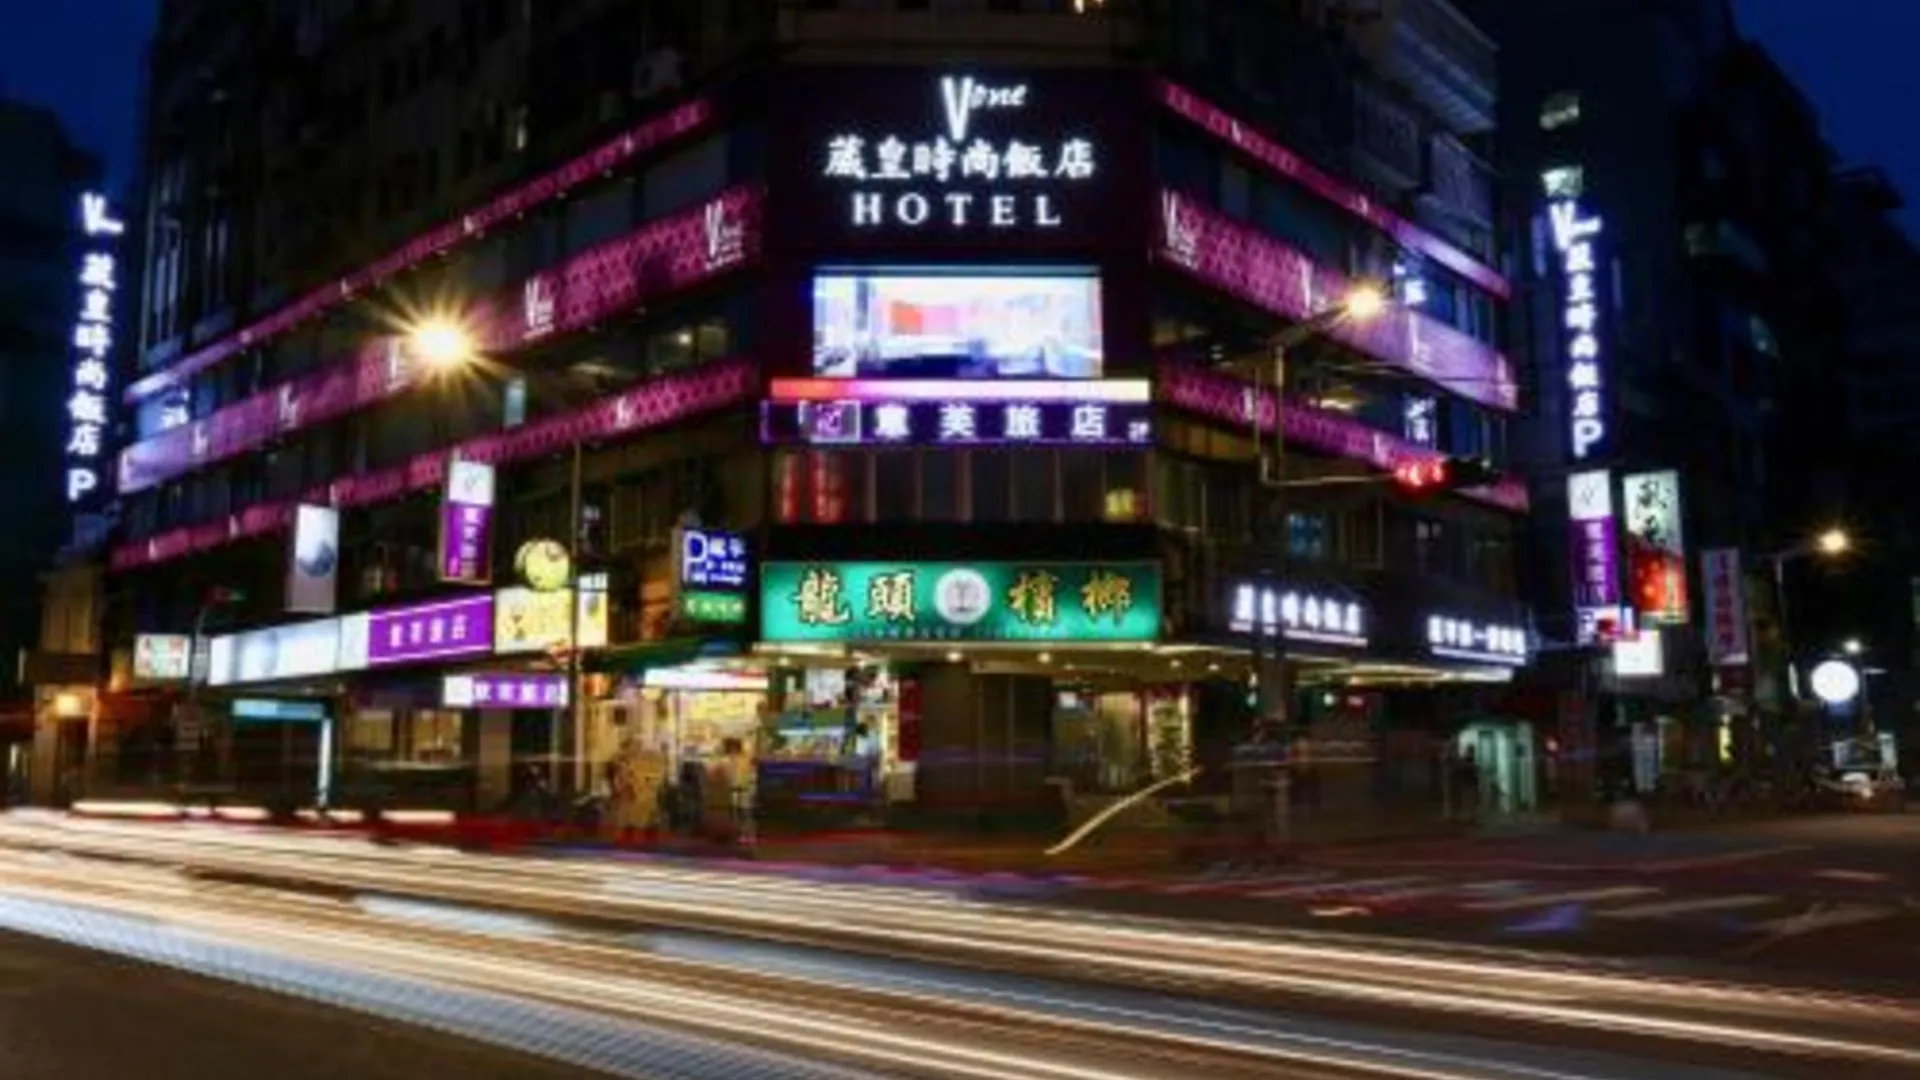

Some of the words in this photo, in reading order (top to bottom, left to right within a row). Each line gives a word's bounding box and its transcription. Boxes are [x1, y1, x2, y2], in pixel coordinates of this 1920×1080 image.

[853, 192, 1061, 226] HOTEL
[1573, 418, 1604, 457] P
[69, 468, 97, 500] P
[791, 567, 919, 624] 龍頭
